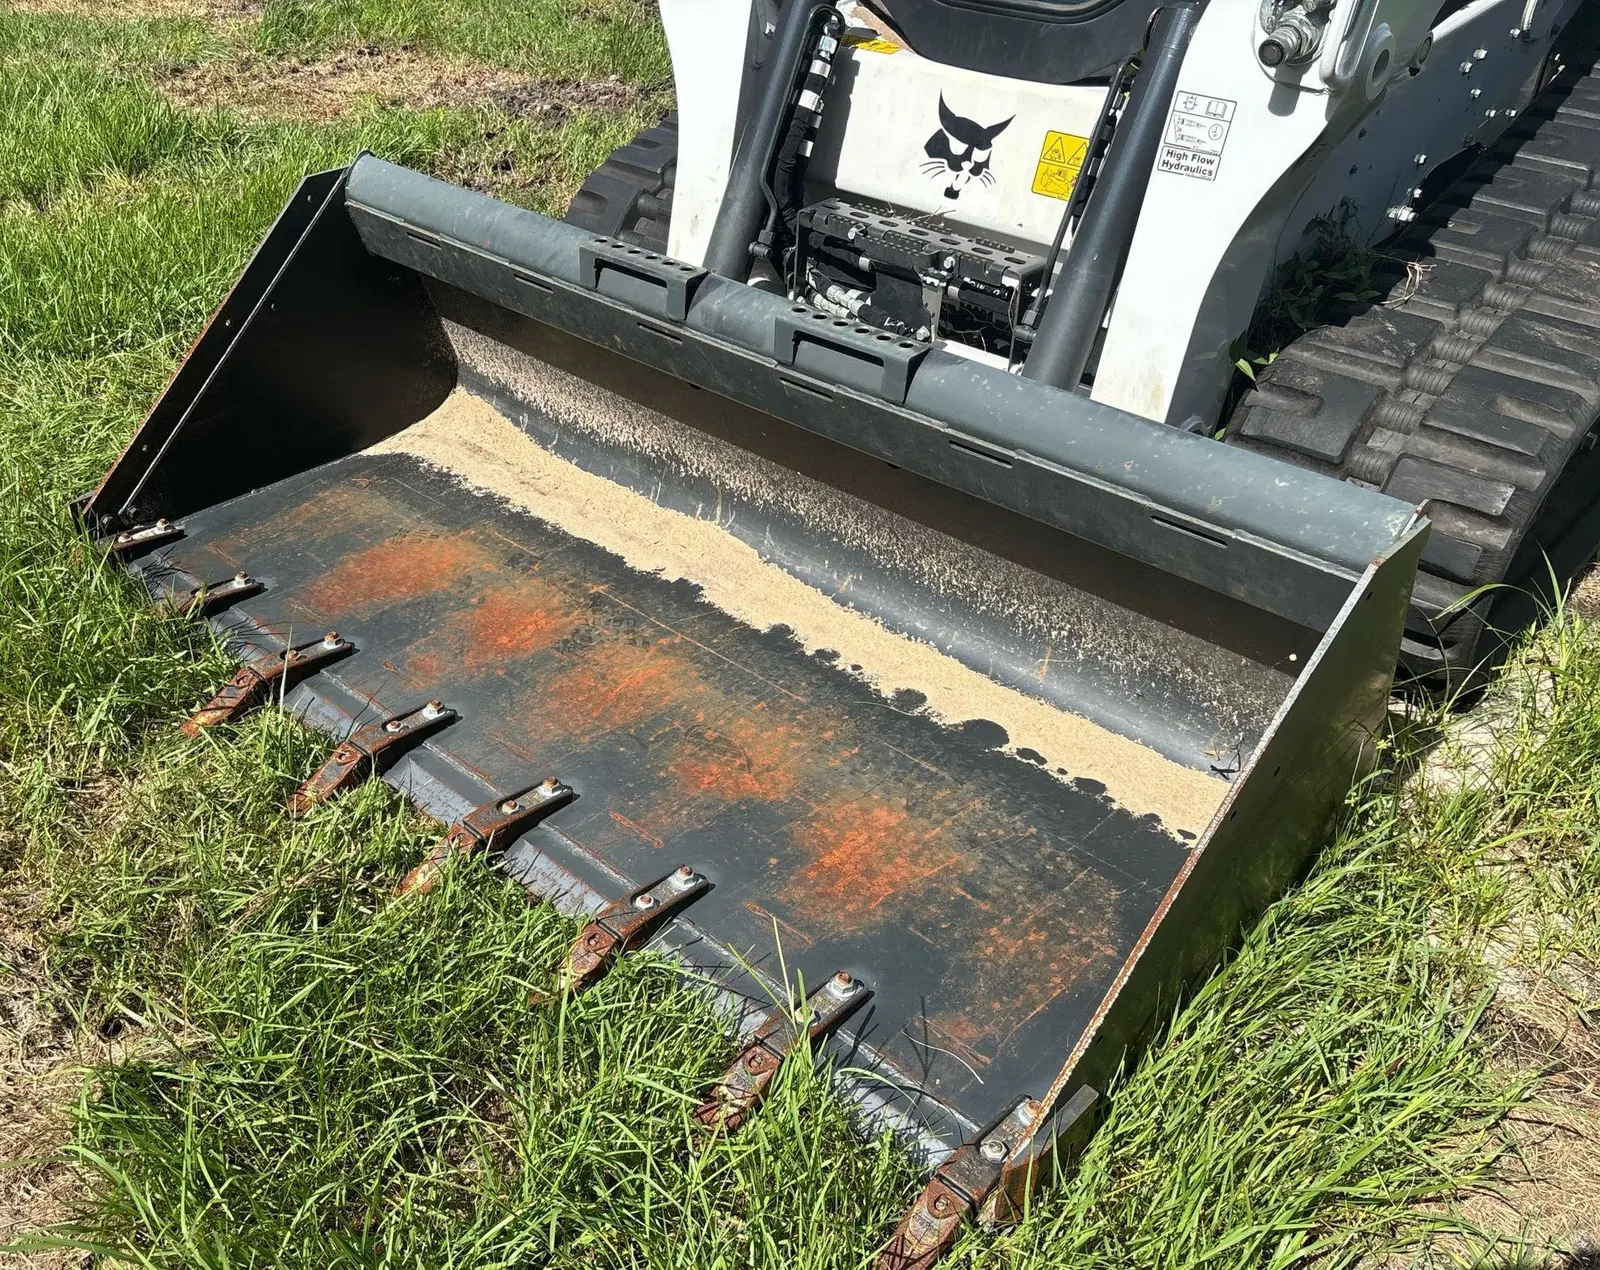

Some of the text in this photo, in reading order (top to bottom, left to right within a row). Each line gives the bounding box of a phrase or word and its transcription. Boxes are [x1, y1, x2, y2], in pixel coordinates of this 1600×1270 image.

[1166, 149, 1188, 161] High
[1191, 154, 1215, 165] Flow
[1161, 159, 1213, 176] Hydraulics
